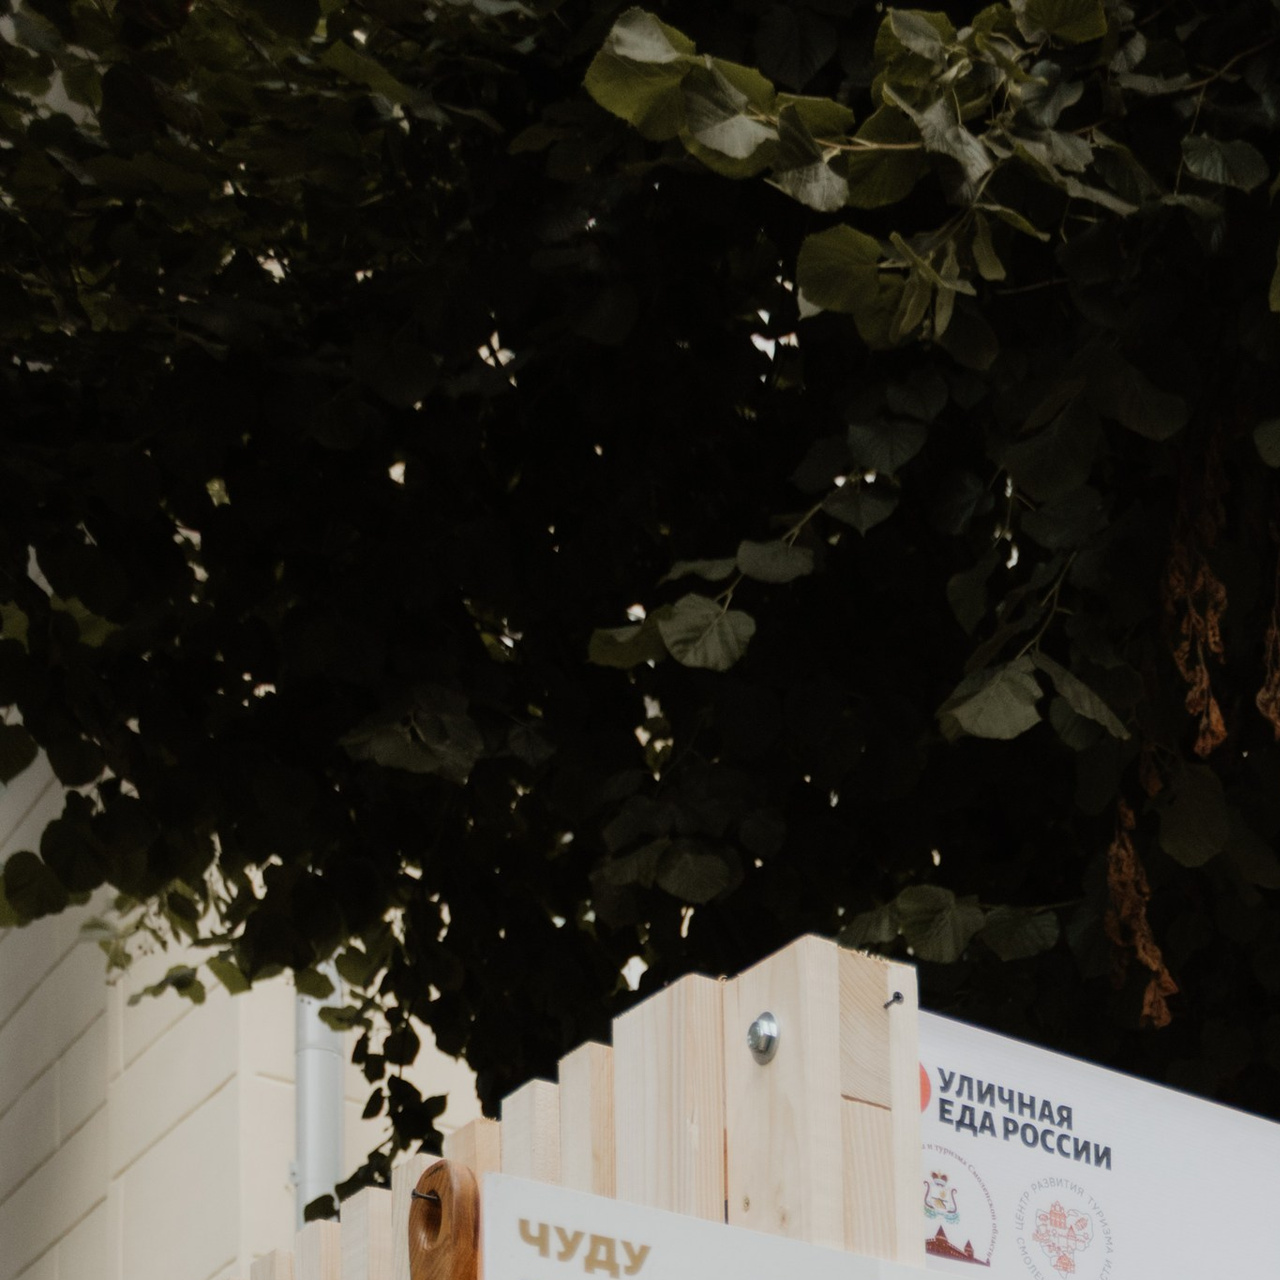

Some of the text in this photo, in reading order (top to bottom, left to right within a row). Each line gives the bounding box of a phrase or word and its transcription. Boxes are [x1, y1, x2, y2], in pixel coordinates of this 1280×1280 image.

[937, 1066, 1074, 1131] УЛИЧНАЯ
[938, 1097, 1113, 1171] ЕДА РОССИИ
[516, 1217, 652, 1280] ЧУДУ
[1015, 1176, 1114, 1255] ЦЕНТР РАЗВИТИЯ ТУРИЗМА
